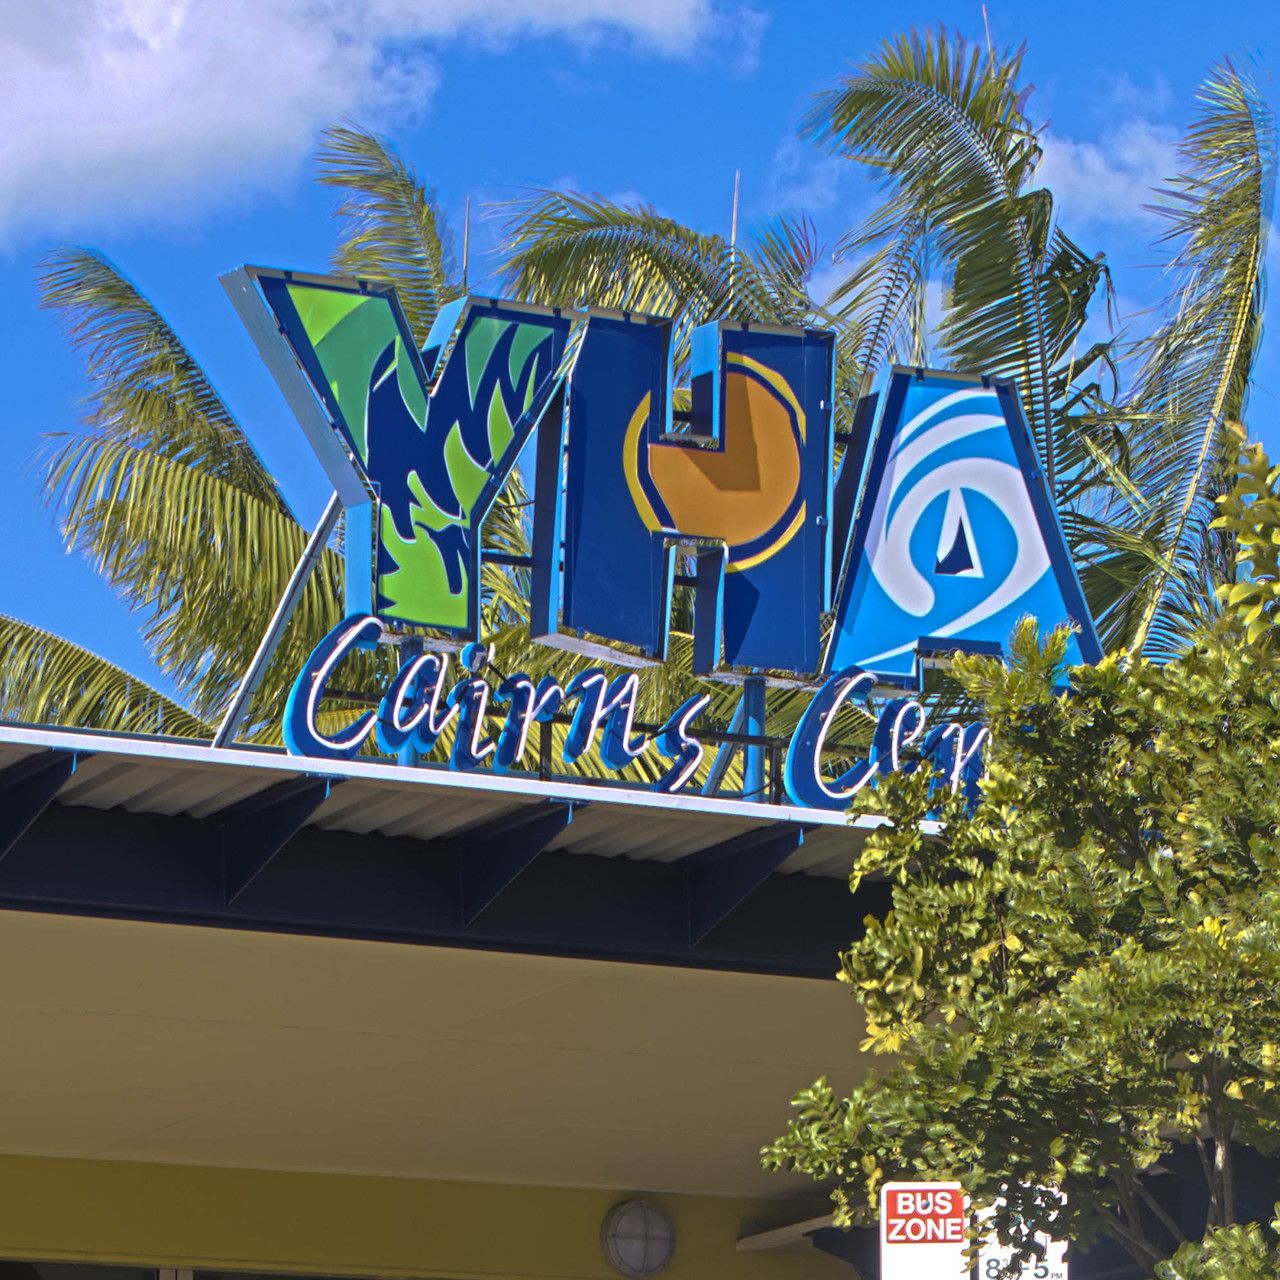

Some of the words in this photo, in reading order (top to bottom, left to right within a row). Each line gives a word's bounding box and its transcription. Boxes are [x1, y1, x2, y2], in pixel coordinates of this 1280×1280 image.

[220, 265, 1105, 690] YHA
[282, 614, 712, 794] Cairns
[888, 1218, 963, 1241] ZONE
[897, 1191, 953, 1215] BUS
